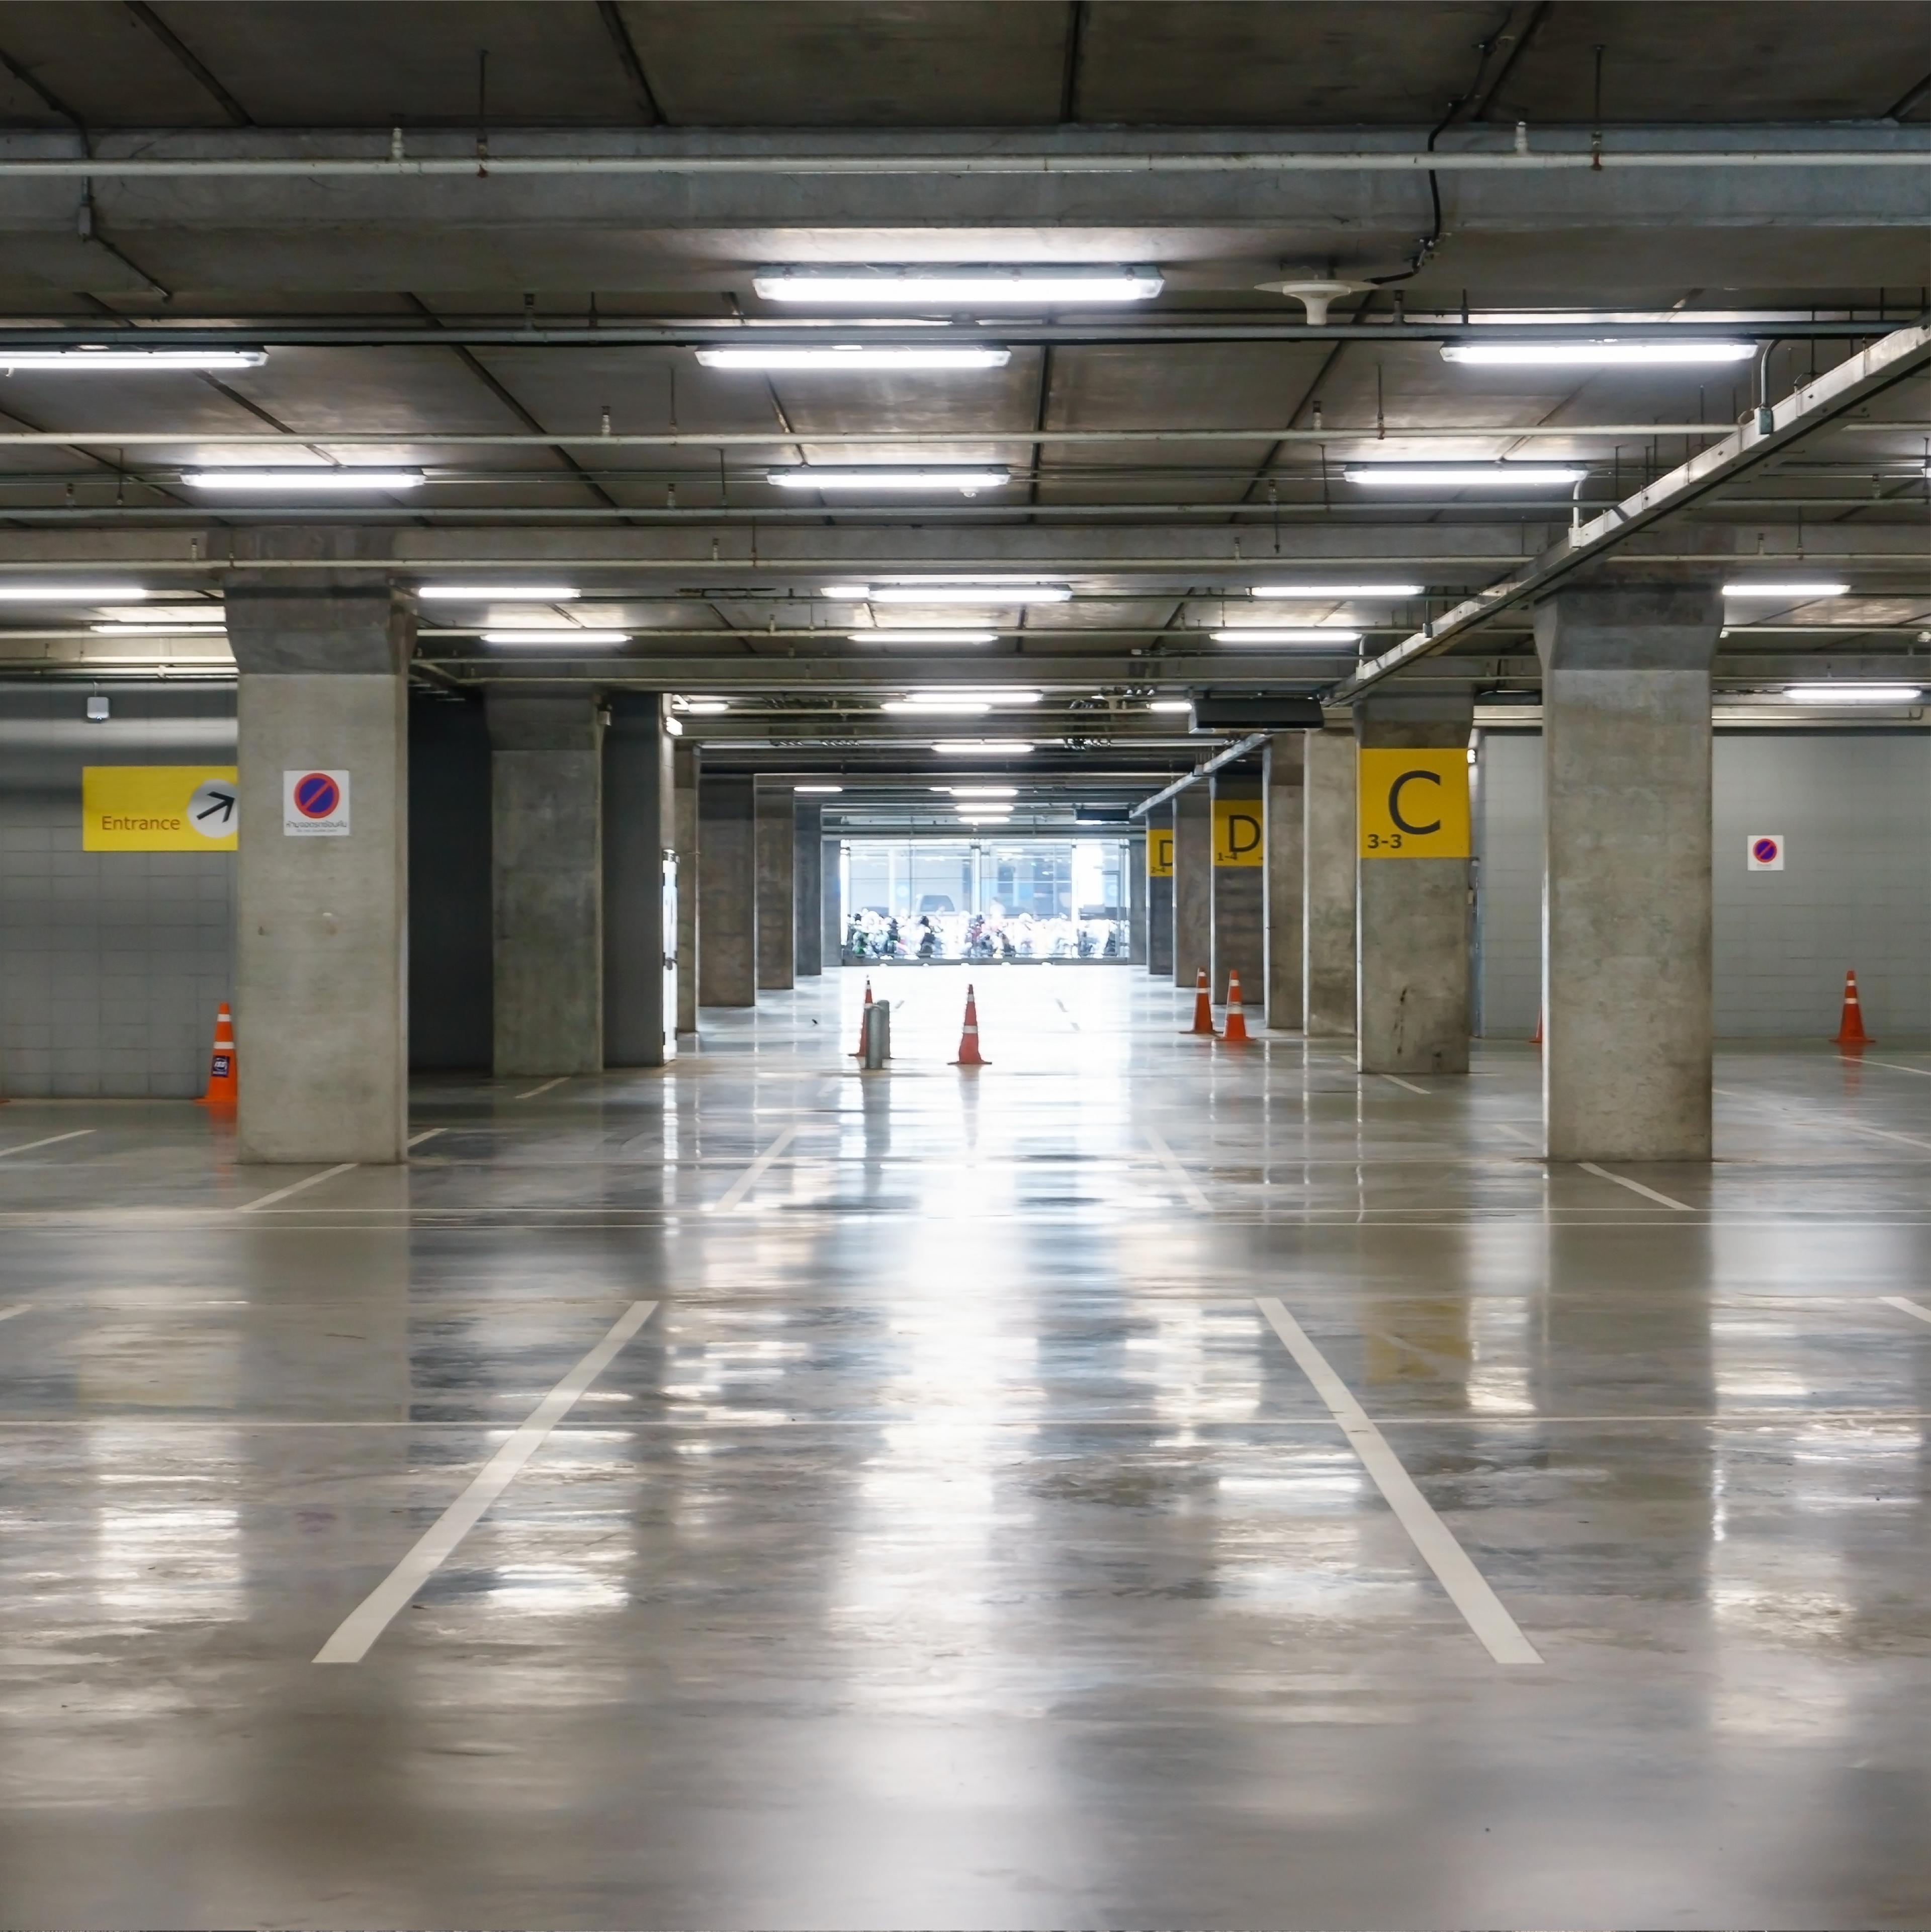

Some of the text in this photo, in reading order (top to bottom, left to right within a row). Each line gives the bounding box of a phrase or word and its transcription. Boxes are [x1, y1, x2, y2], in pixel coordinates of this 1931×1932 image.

[1388, 770, 1440, 835] C
[102, 815, 181, 830] Entrance
[1229, 815, 1261, 852] D
[1367, 833, 1402, 849] 3-3
